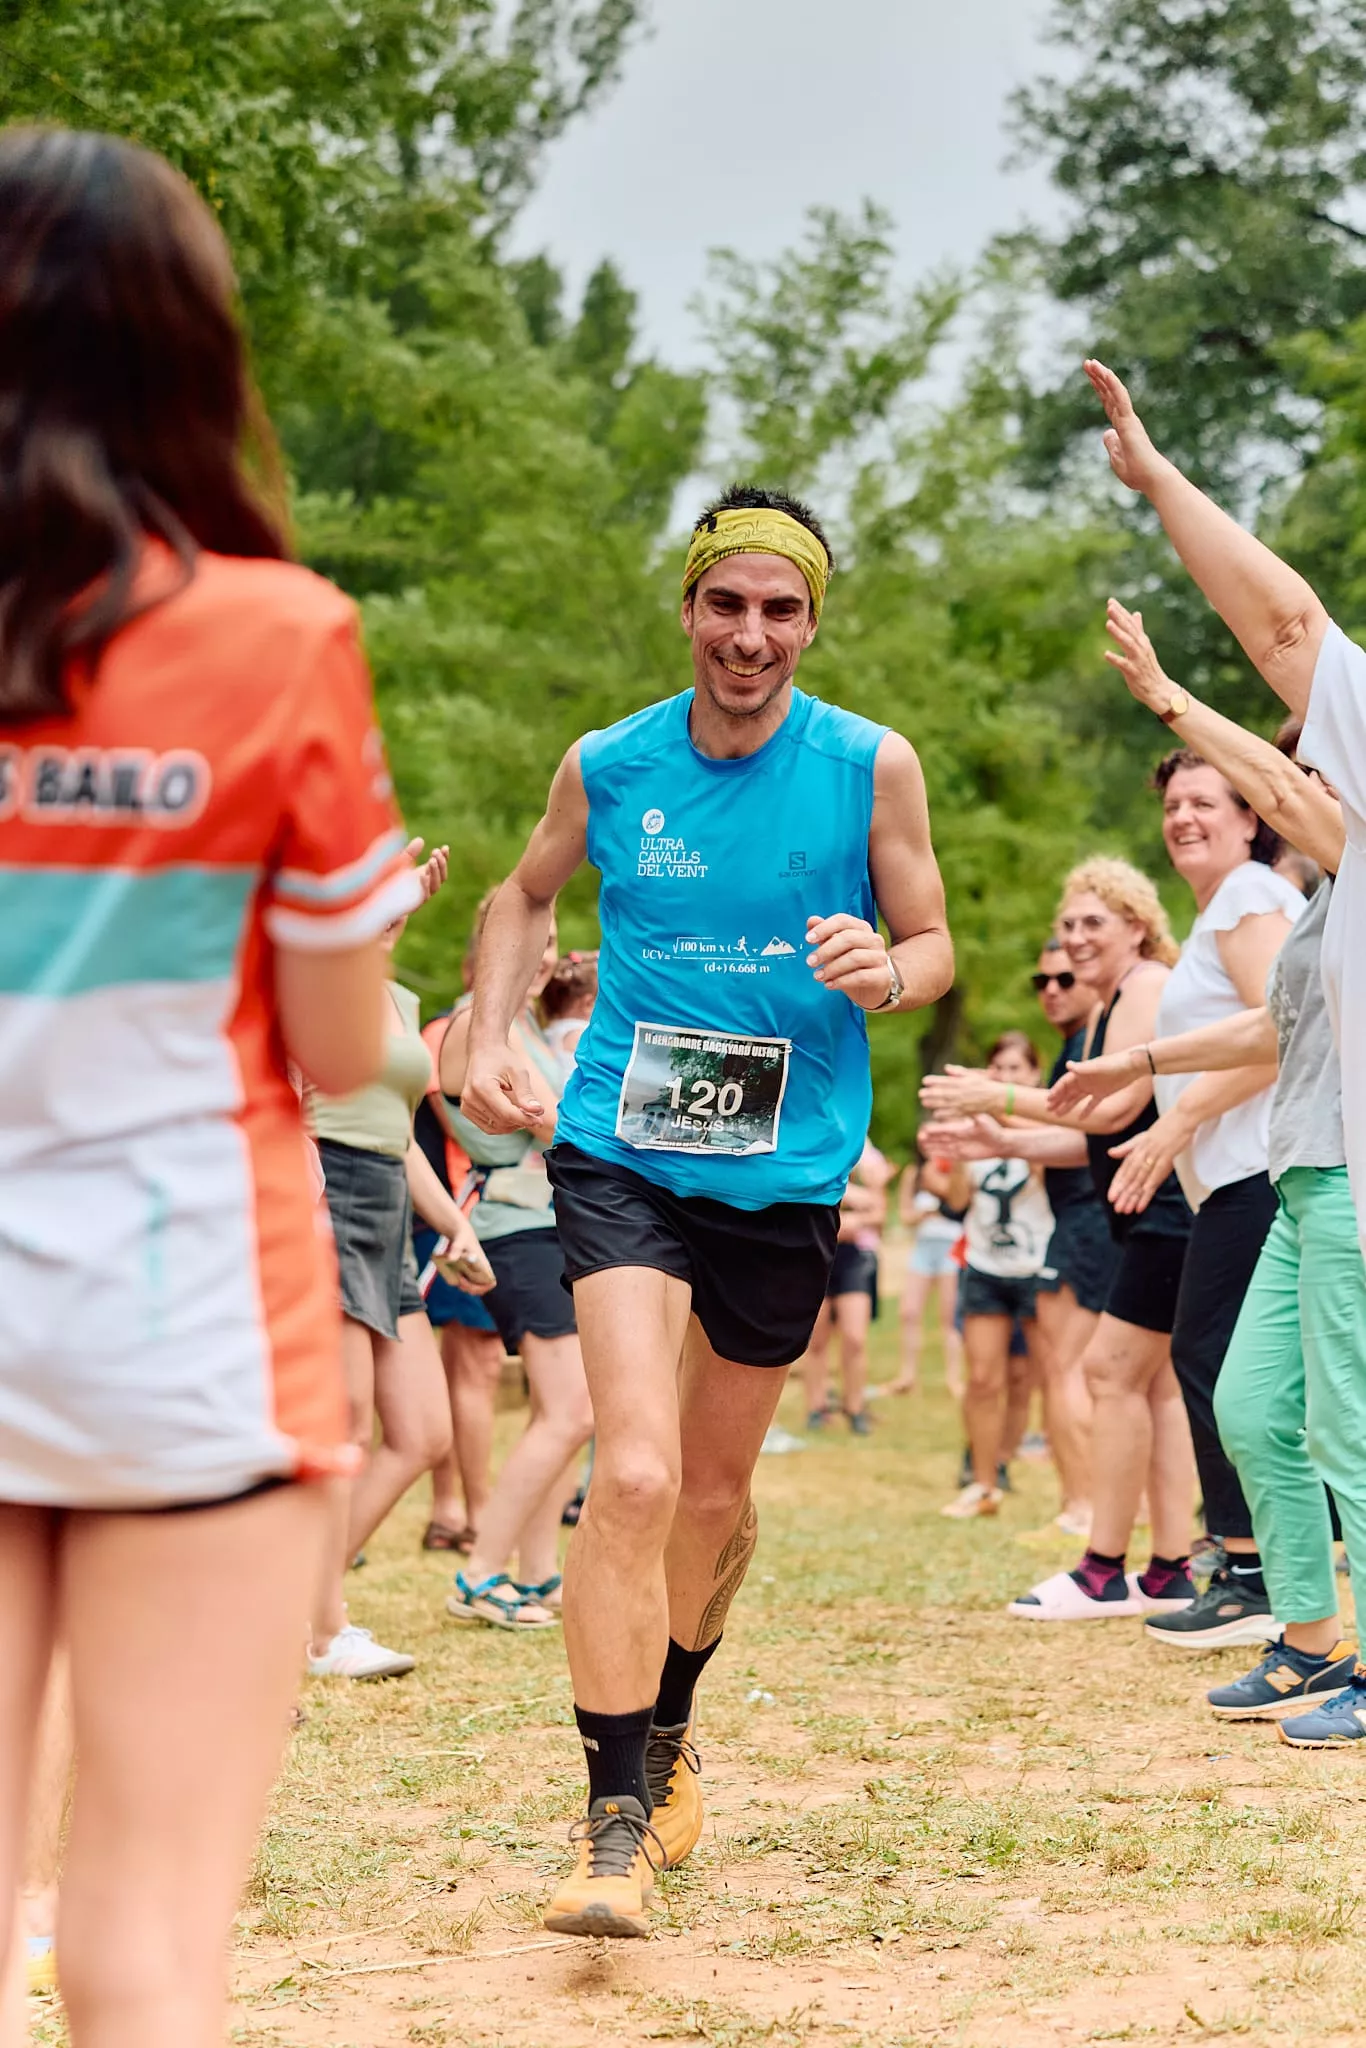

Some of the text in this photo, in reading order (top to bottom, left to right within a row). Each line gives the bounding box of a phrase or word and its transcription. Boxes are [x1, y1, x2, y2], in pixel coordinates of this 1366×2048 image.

[640, 837, 685, 850] ULTRA
[638, 851, 701, 864] CAVALLS
[637, 864, 708, 878] DEL VENT
[700, 942, 716, 953] km
[729, 963, 757, 973] 6.668
[760, 964, 770, 973] m
[702, 1040, 750, 1056] BACKYARD
[751, 1046, 779, 1059] ULTRA
[665, 1076, 743, 1117] 120
[671, 1114, 724, 1132] JESUS
